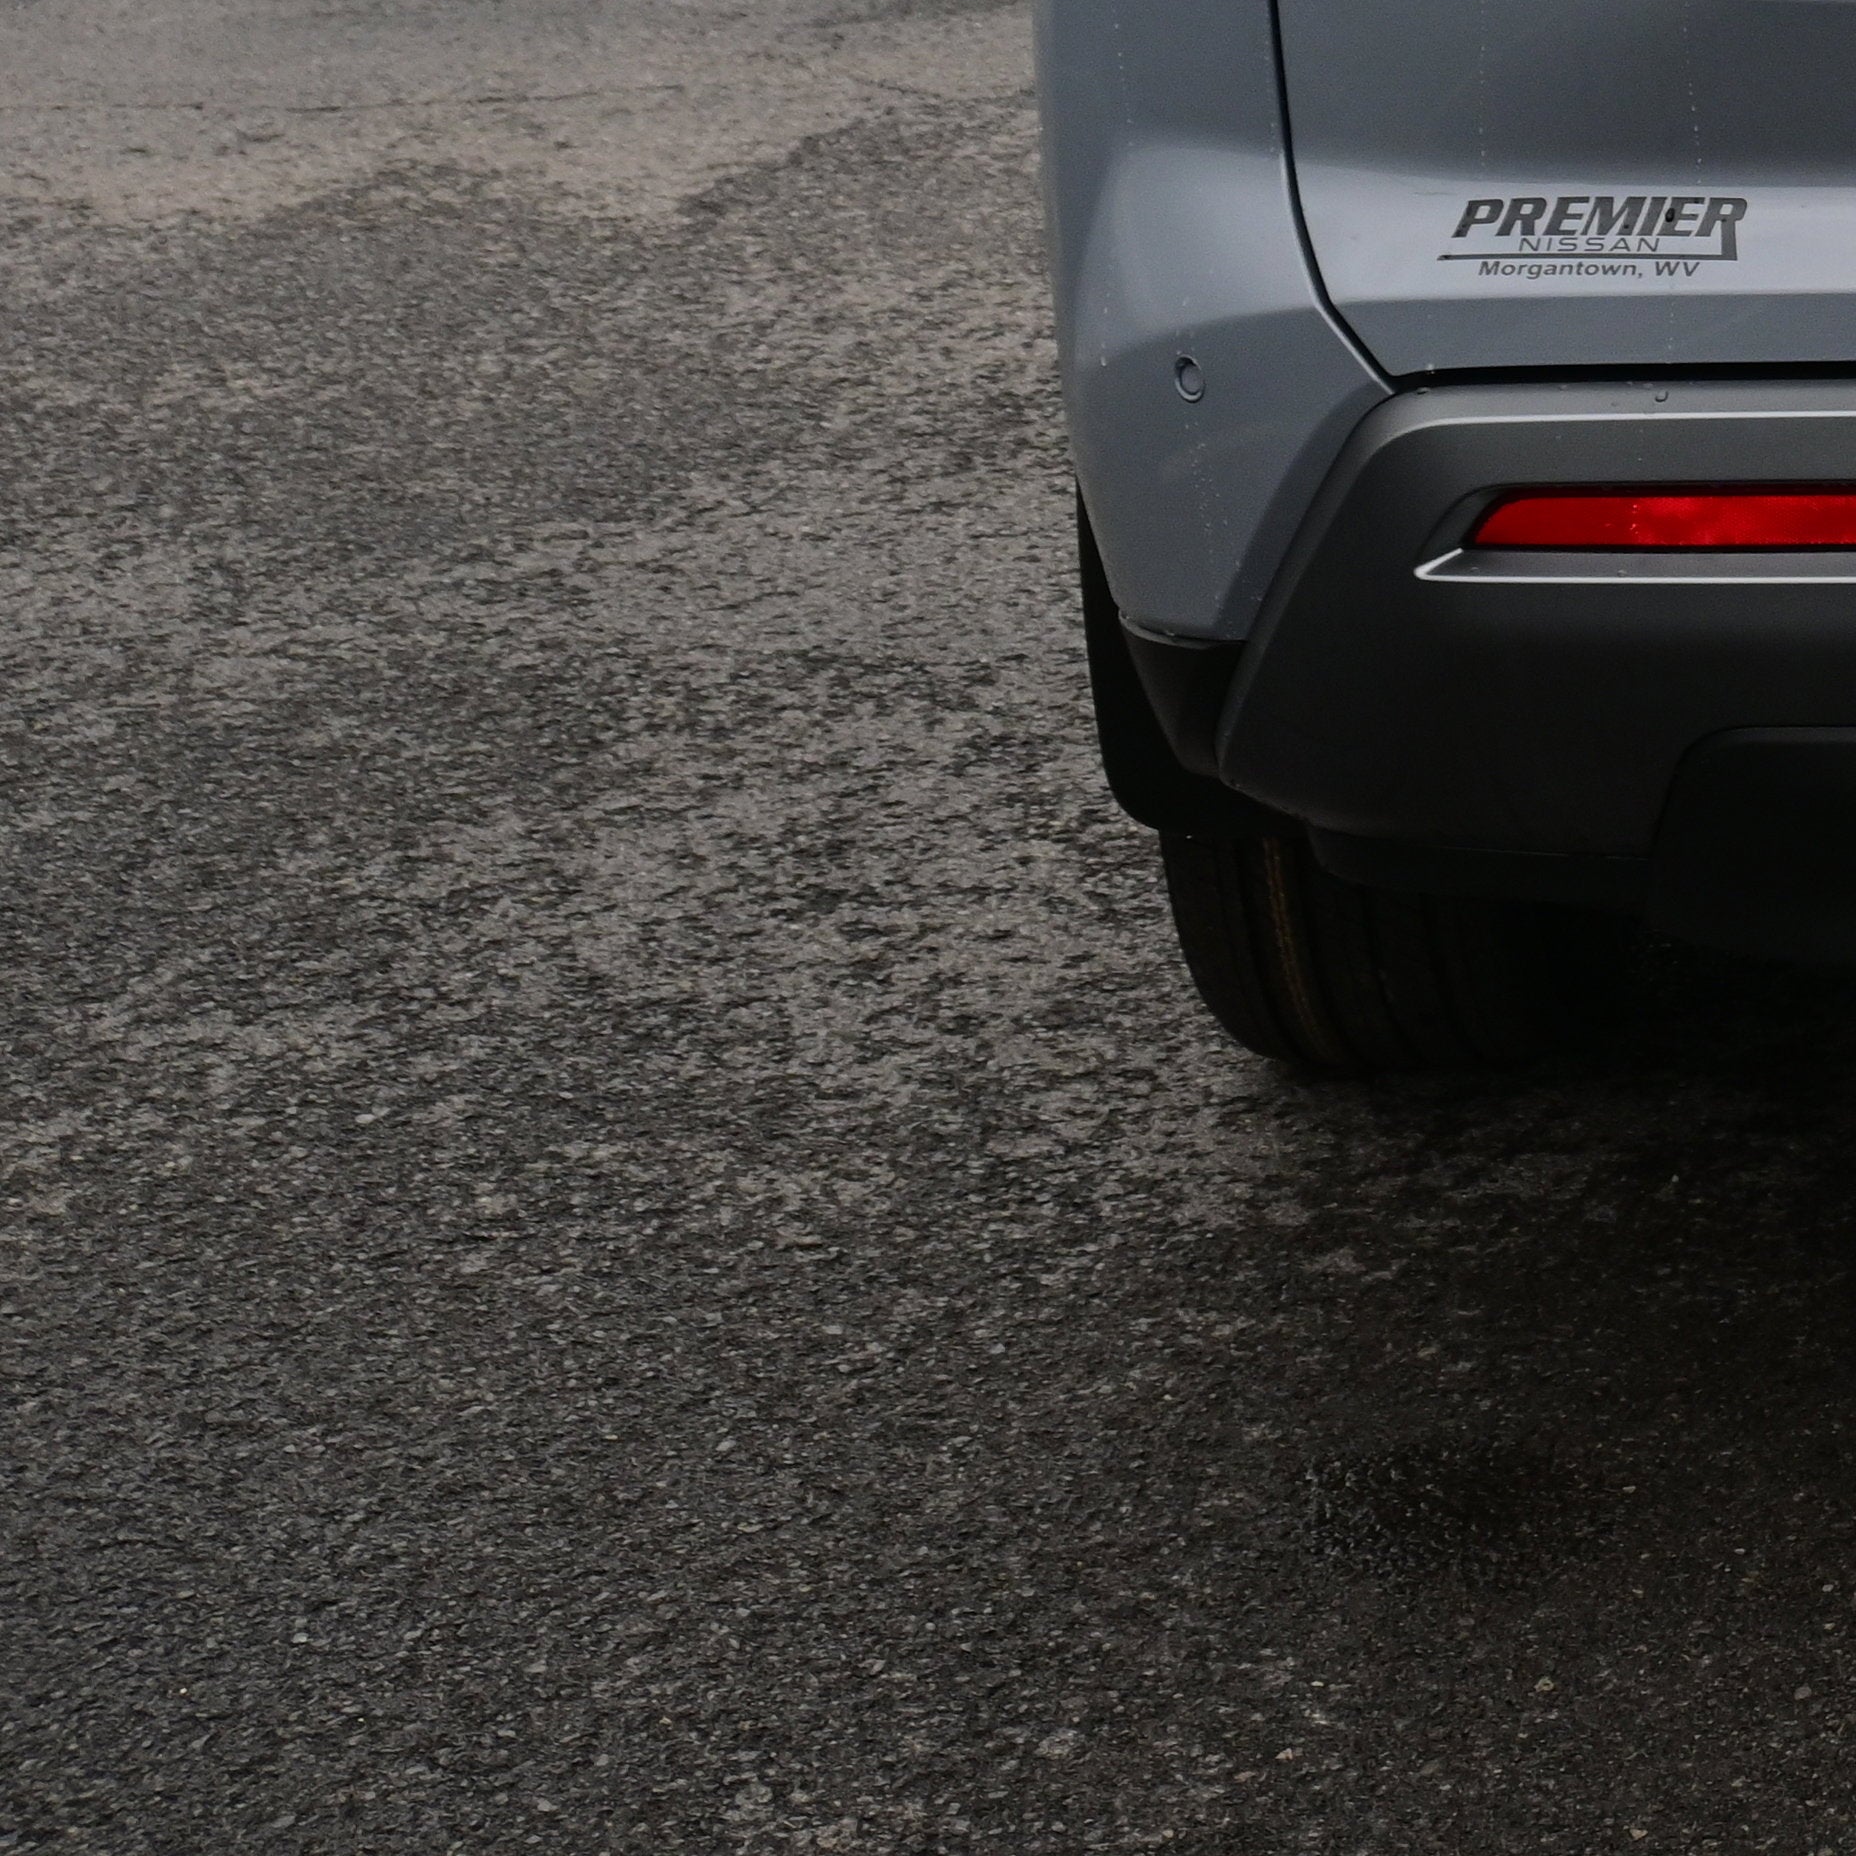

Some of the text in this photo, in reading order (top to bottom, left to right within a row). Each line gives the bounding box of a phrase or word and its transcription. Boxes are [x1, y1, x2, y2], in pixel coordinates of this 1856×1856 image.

[1450, 196, 1748, 256] PREMIER
[1518, 237, 1661, 252] NISSAN
[1478, 260, 1700, 280] Morgantown, WV
